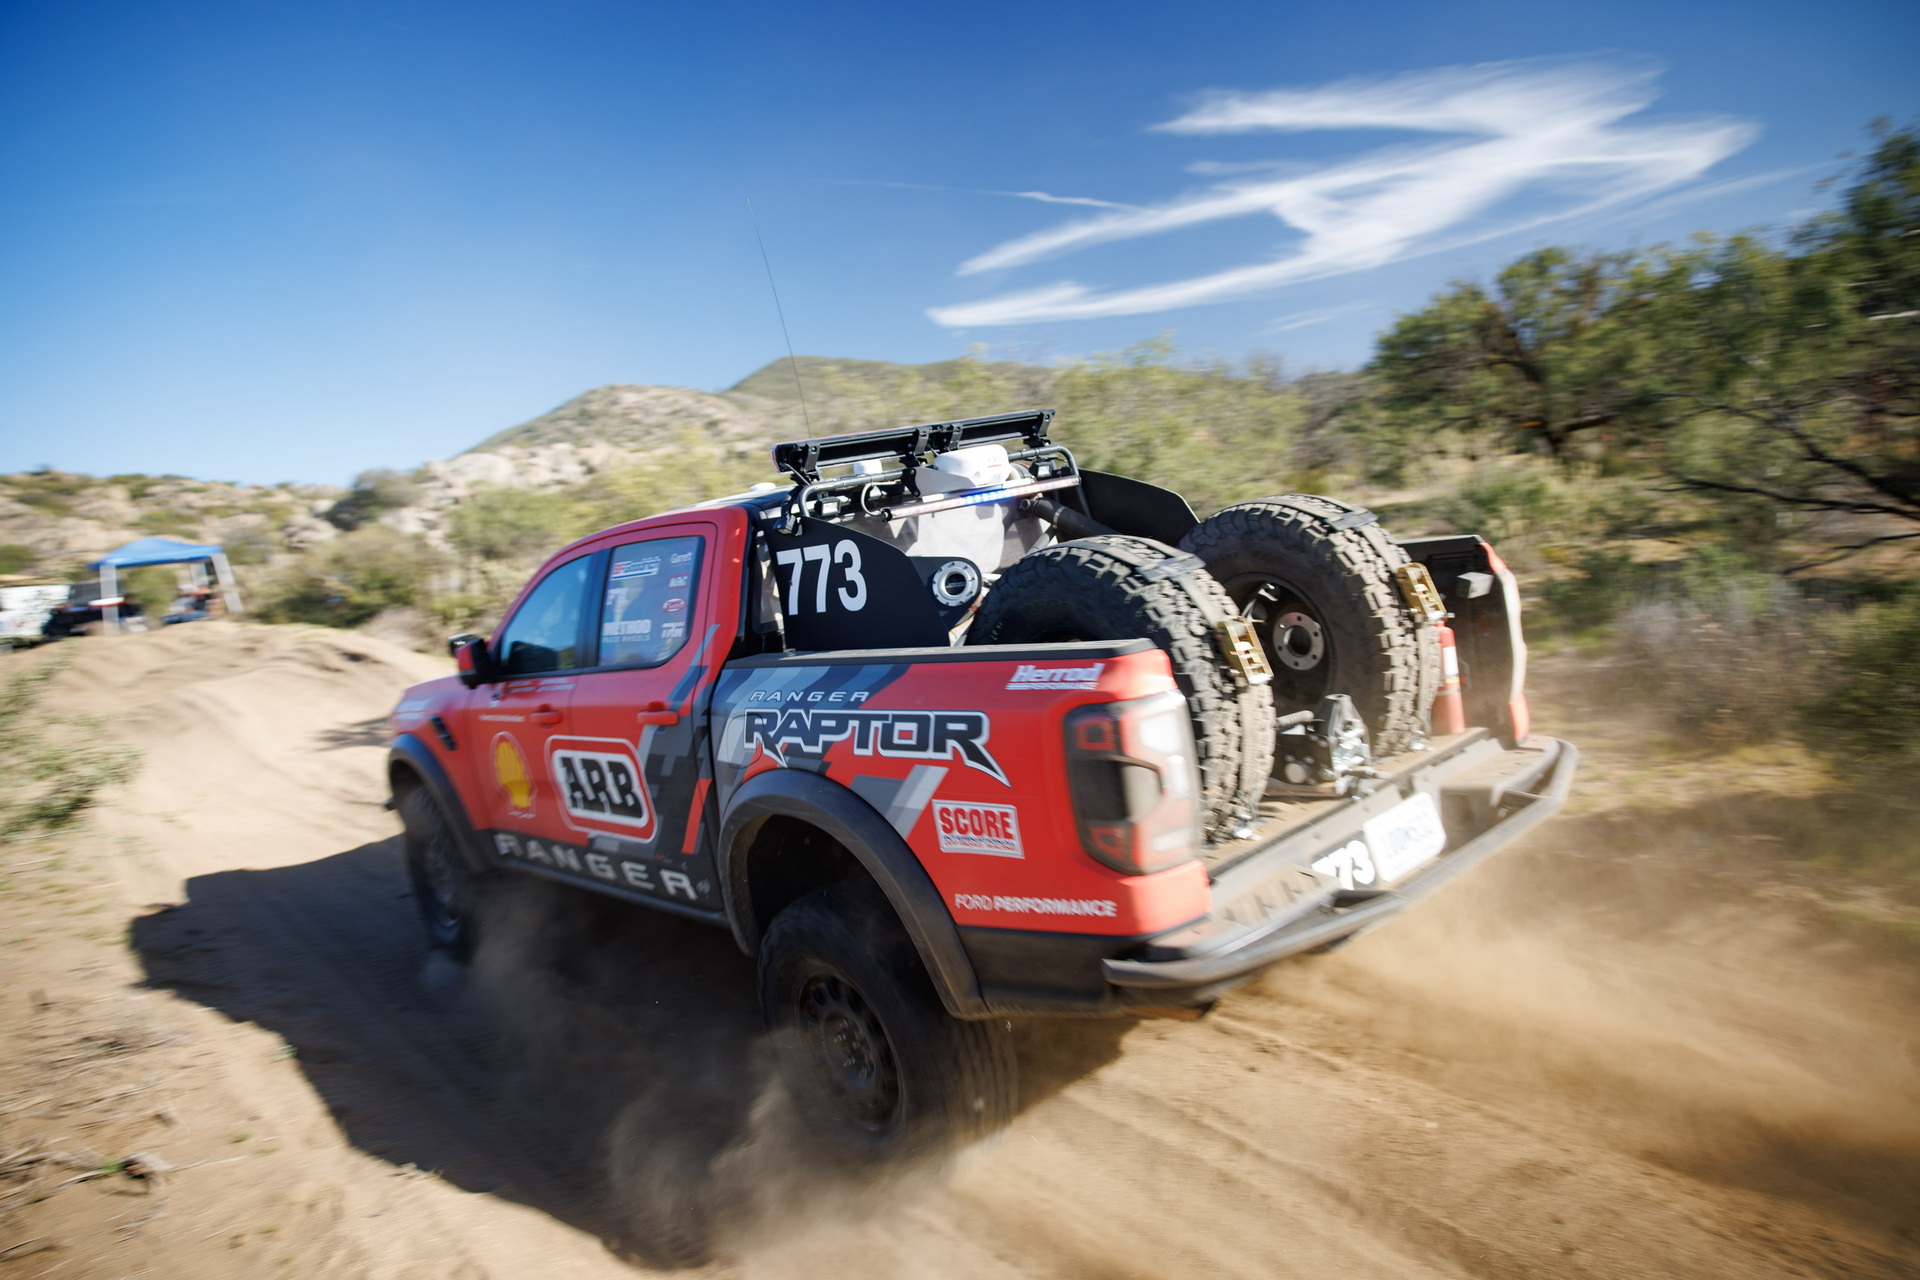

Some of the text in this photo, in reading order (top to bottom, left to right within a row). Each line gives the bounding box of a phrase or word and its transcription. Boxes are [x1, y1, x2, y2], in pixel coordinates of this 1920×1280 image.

[777, 539, 867, 615] 773
[602, 619, 651, 636] METHOD
[1009, 663, 1105, 682] Herrod
[750, 690, 870, 702] RANGER
[743, 708, 1014, 790] RAPTOR
[559, 756, 643, 819] ARB
[939, 807, 1015, 839] SCORE
[494, 833, 698, 901] RANGER
[955, 893, 1117, 918] FORD PERFORMANCE
